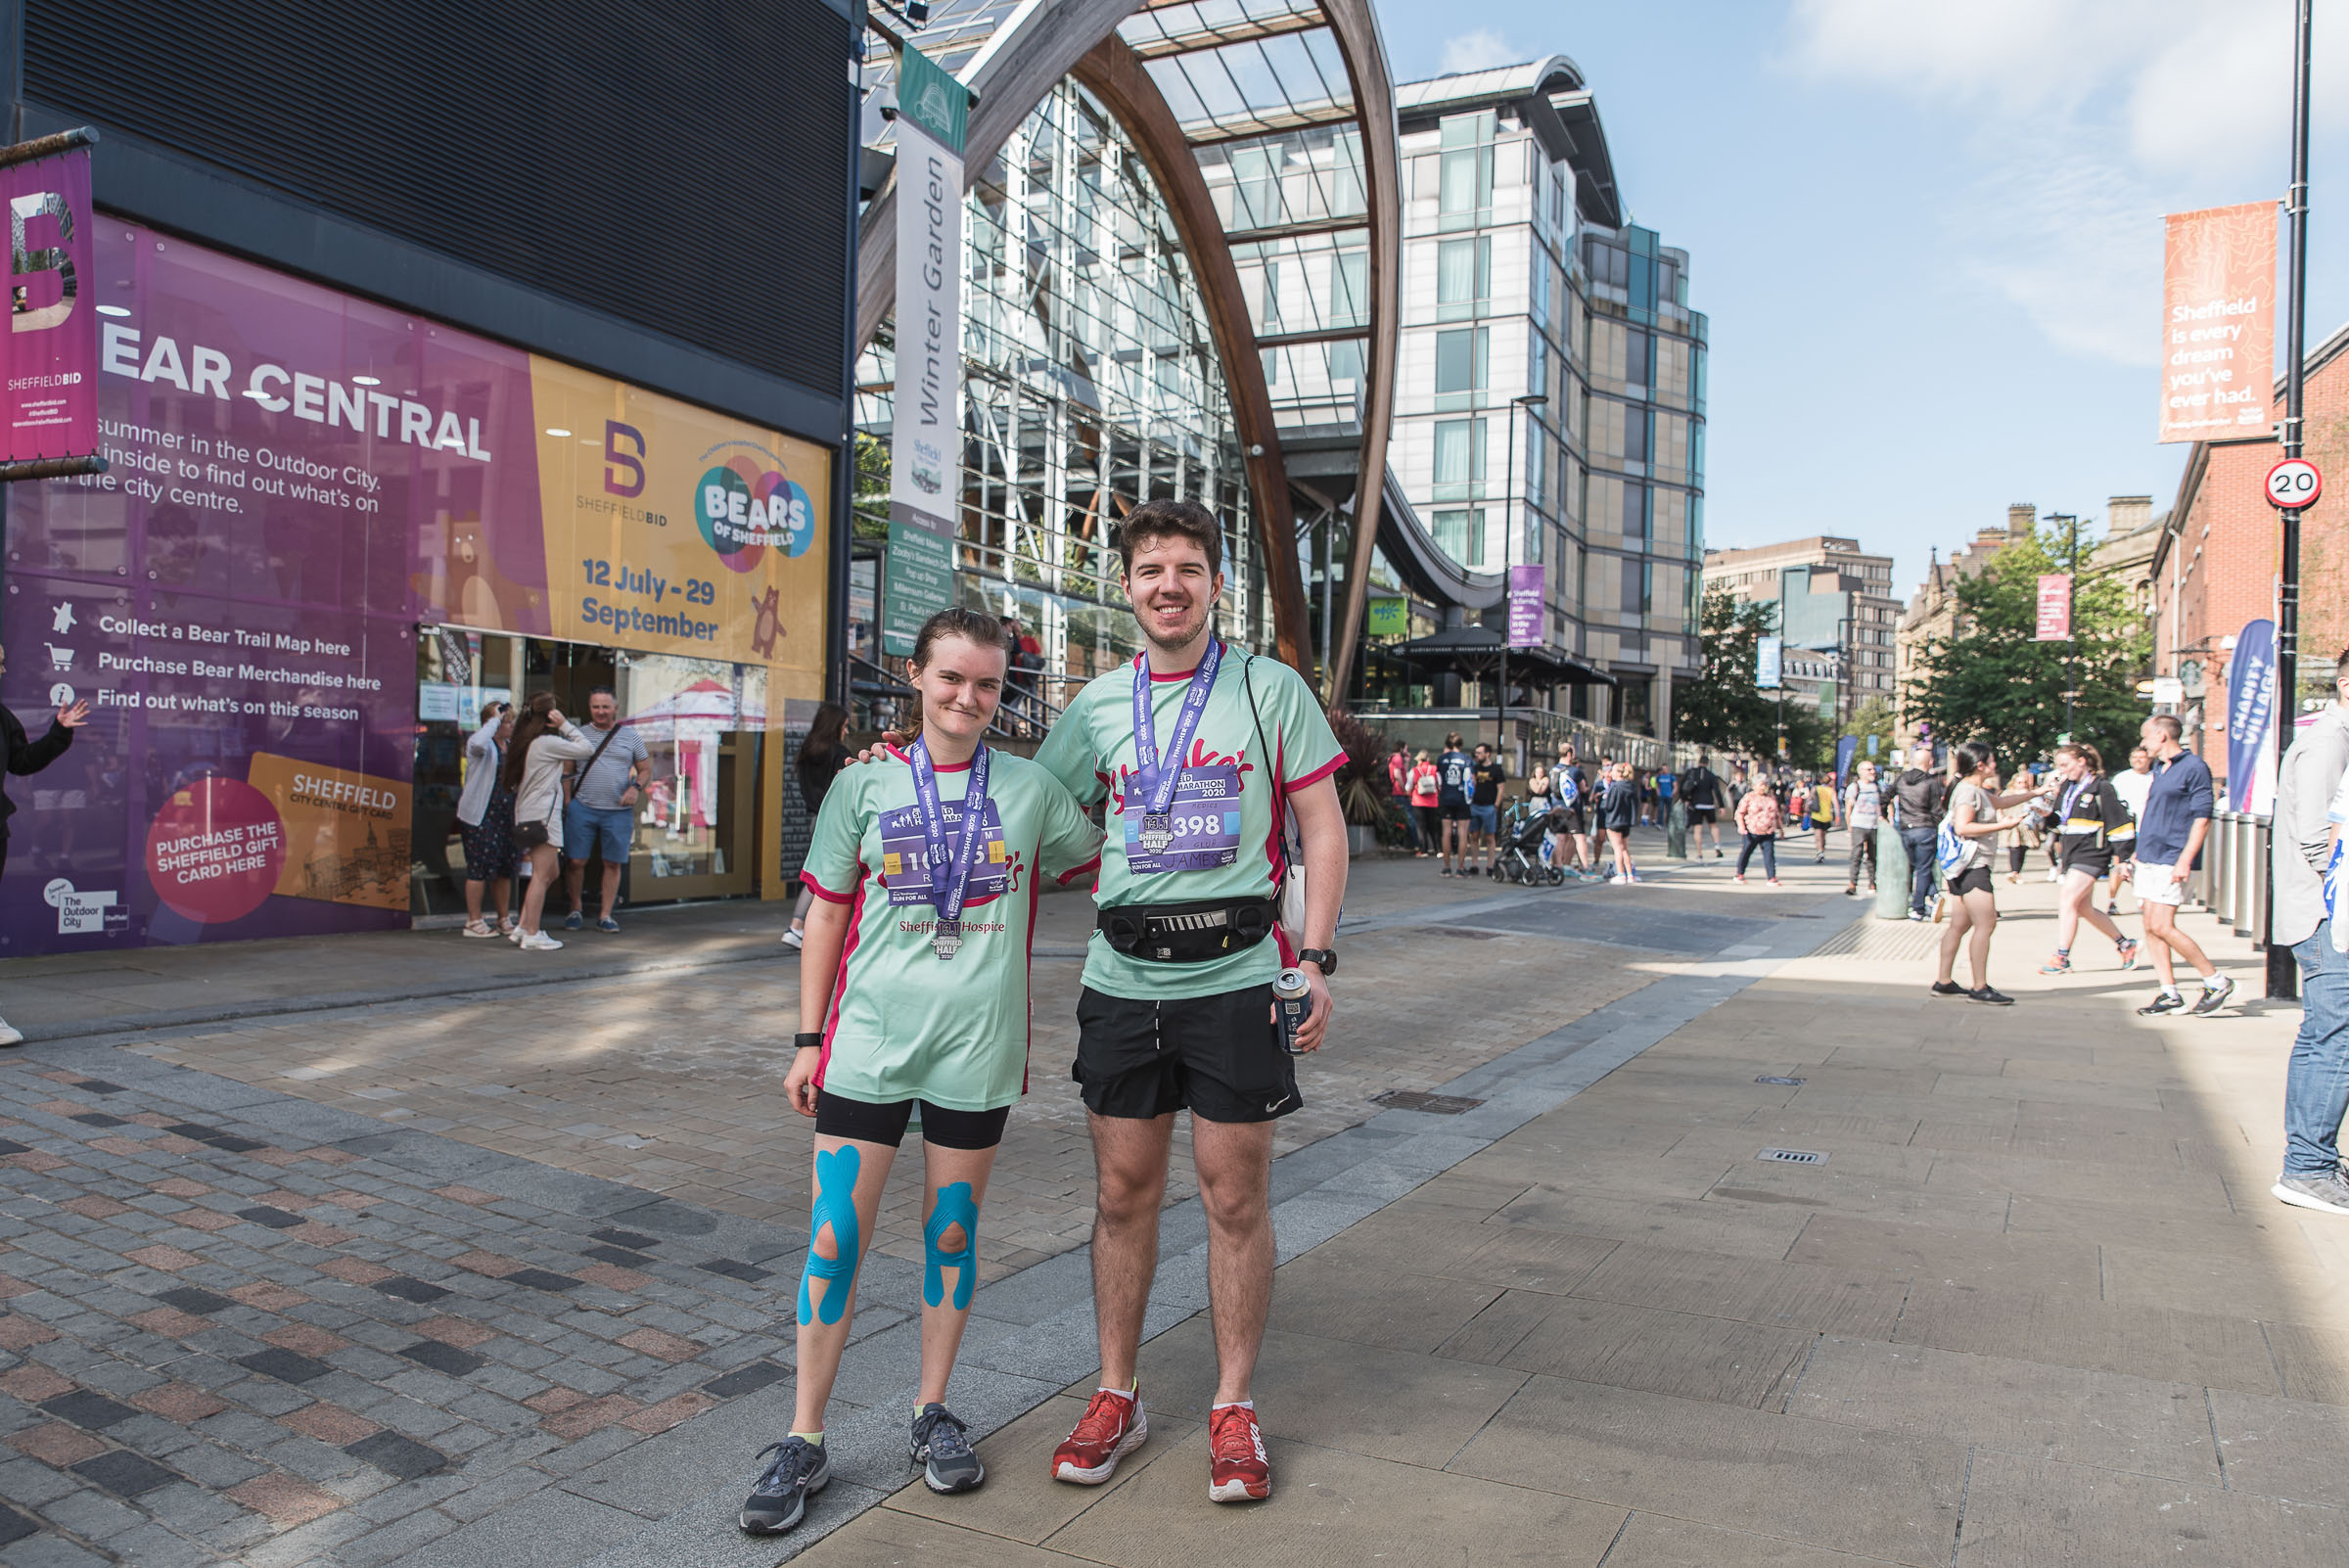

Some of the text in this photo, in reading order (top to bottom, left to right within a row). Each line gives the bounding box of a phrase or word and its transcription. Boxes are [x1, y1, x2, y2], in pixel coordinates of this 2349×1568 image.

[920, 155, 944, 427] Winter Garden
[2171, 296, 2257, 323] Sheffield
[2171, 324, 2242, 345] is every
[2171, 347, 2234, 366] dream
[2169, 367, 2233, 392] you've
[2169, 385, 2256, 408] ever had.
[250, 363, 491, 463] CENTRAL
[191, 434, 209, 456] in
[215, 440, 250, 463] the
[256, 448, 338, 482] Outdoor
[343, 466, 381, 493] City.
[104, 442, 379, 514] inside to find out what's on
[2275, 473, 2315, 493] 20
[124, 478, 162, 504] city
[170, 487, 244, 514] centre.
[705, 484, 806, 531] BEARS
[713, 521, 795, 547] OF SHEFFIELD
[581, 559, 611, 587] 12
[614, 567, 667, 602] July
[686, 581, 715, 606] 29
[581, 597, 719, 641] September
[99, 616, 350, 656] Collect a Bear Trail Map here
[99, 652, 382, 691] Purchase Bear Merchandise here
[98, 689, 359, 720] Find out what's on this season
[2231, 655, 2264, 741] CHARITY
[2242, 664, 2274, 744] VILLAGE
[1174, 727, 1187, 759] FINISHER
[1183, 710, 1194, 728] 2020
[293, 774, 396, 809] SHEFFIELD
[1175, 779, 1225, 791] MARATHON
[1201, 788, 1225, 797] 2020
[290, 793, 312, 805] CITY
[312, 798, 348, 811] CENTRE
[369, 808, 393, 820] CARD
[924, 790, 939, 838] FINISHER 2020
[1138, 833, 1174, 842] SHEFFIELD
[1144, 818, 1169, 830] 13.1
[1174, 814, 1221, 837] 398
[156, 821, 277, 856] PURCHASE THE
[961, 832, 973, 864] FINISHER
[1143, 841, 1169, 850] HALF
[157, 837, 279, 872] SHEFFIELD GIFT
[1165, 853, 1221, 869] JAMES
[176, 855, 267, 884] CARD HERE
[64, 906, 99, 916] Outdoor
[65, 897, 81, 906] The
[63, 917, 81, 928] City
[899, 920, 1005, 935] Sheffi Hospice
[939, 923, 959, 936] 13.1
[936, 945, 957, 954] HALF
[1250, 1421, 1269, 1467] HOKA
